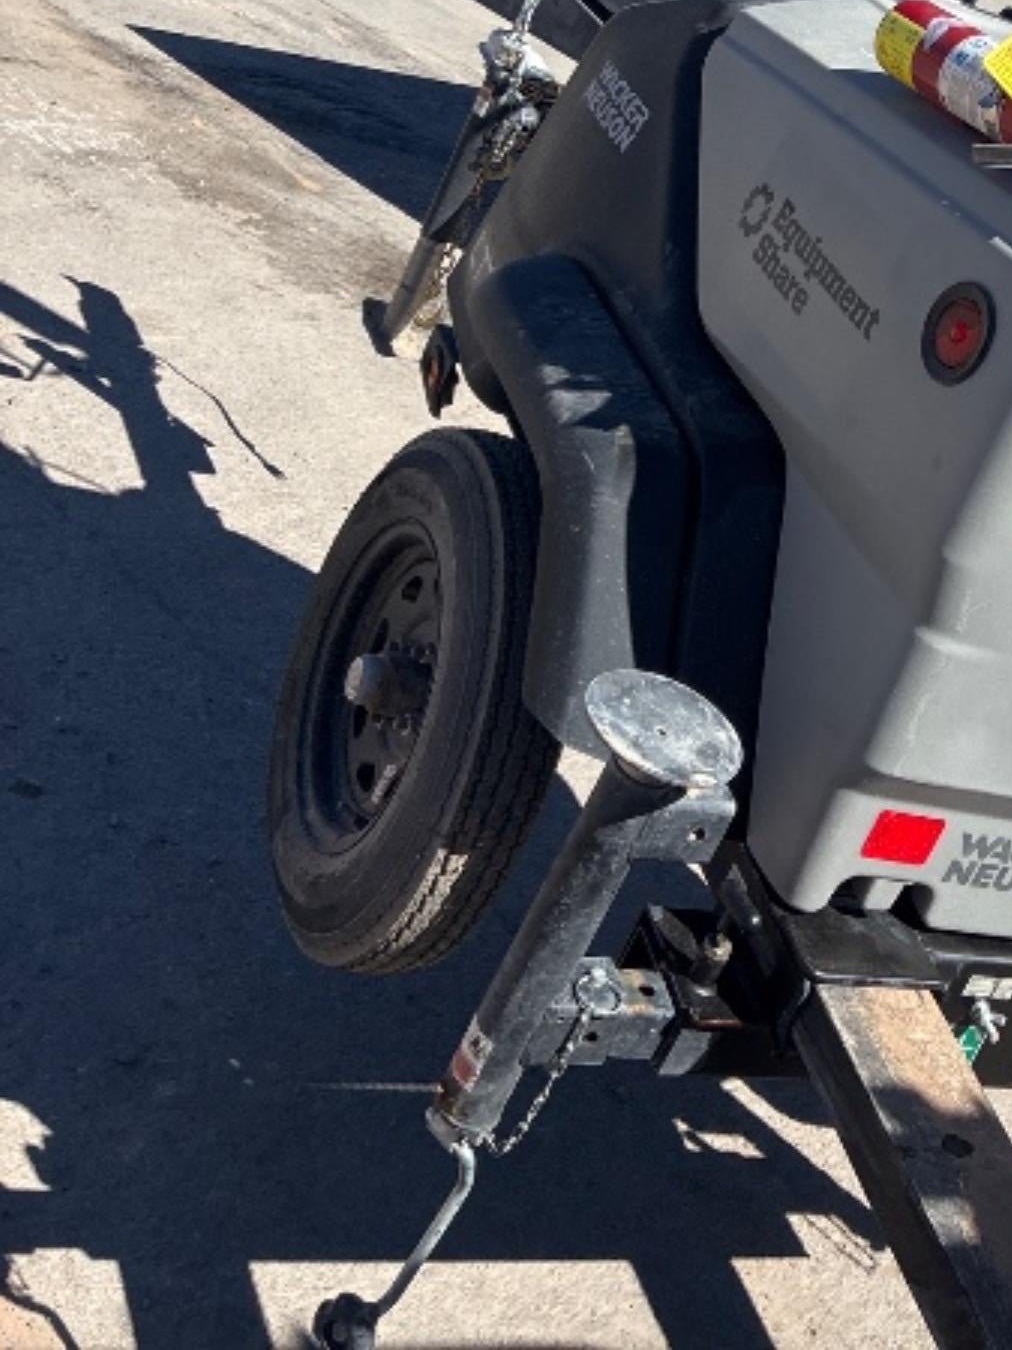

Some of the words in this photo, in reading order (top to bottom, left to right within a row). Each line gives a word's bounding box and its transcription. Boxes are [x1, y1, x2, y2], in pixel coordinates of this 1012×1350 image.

[583, 78, 636, 154] NEUSON
[599, 60, 649, 130] WACKER
[751, 233, 810, 316] Share
[771, 197, 882, 341] Equipment
